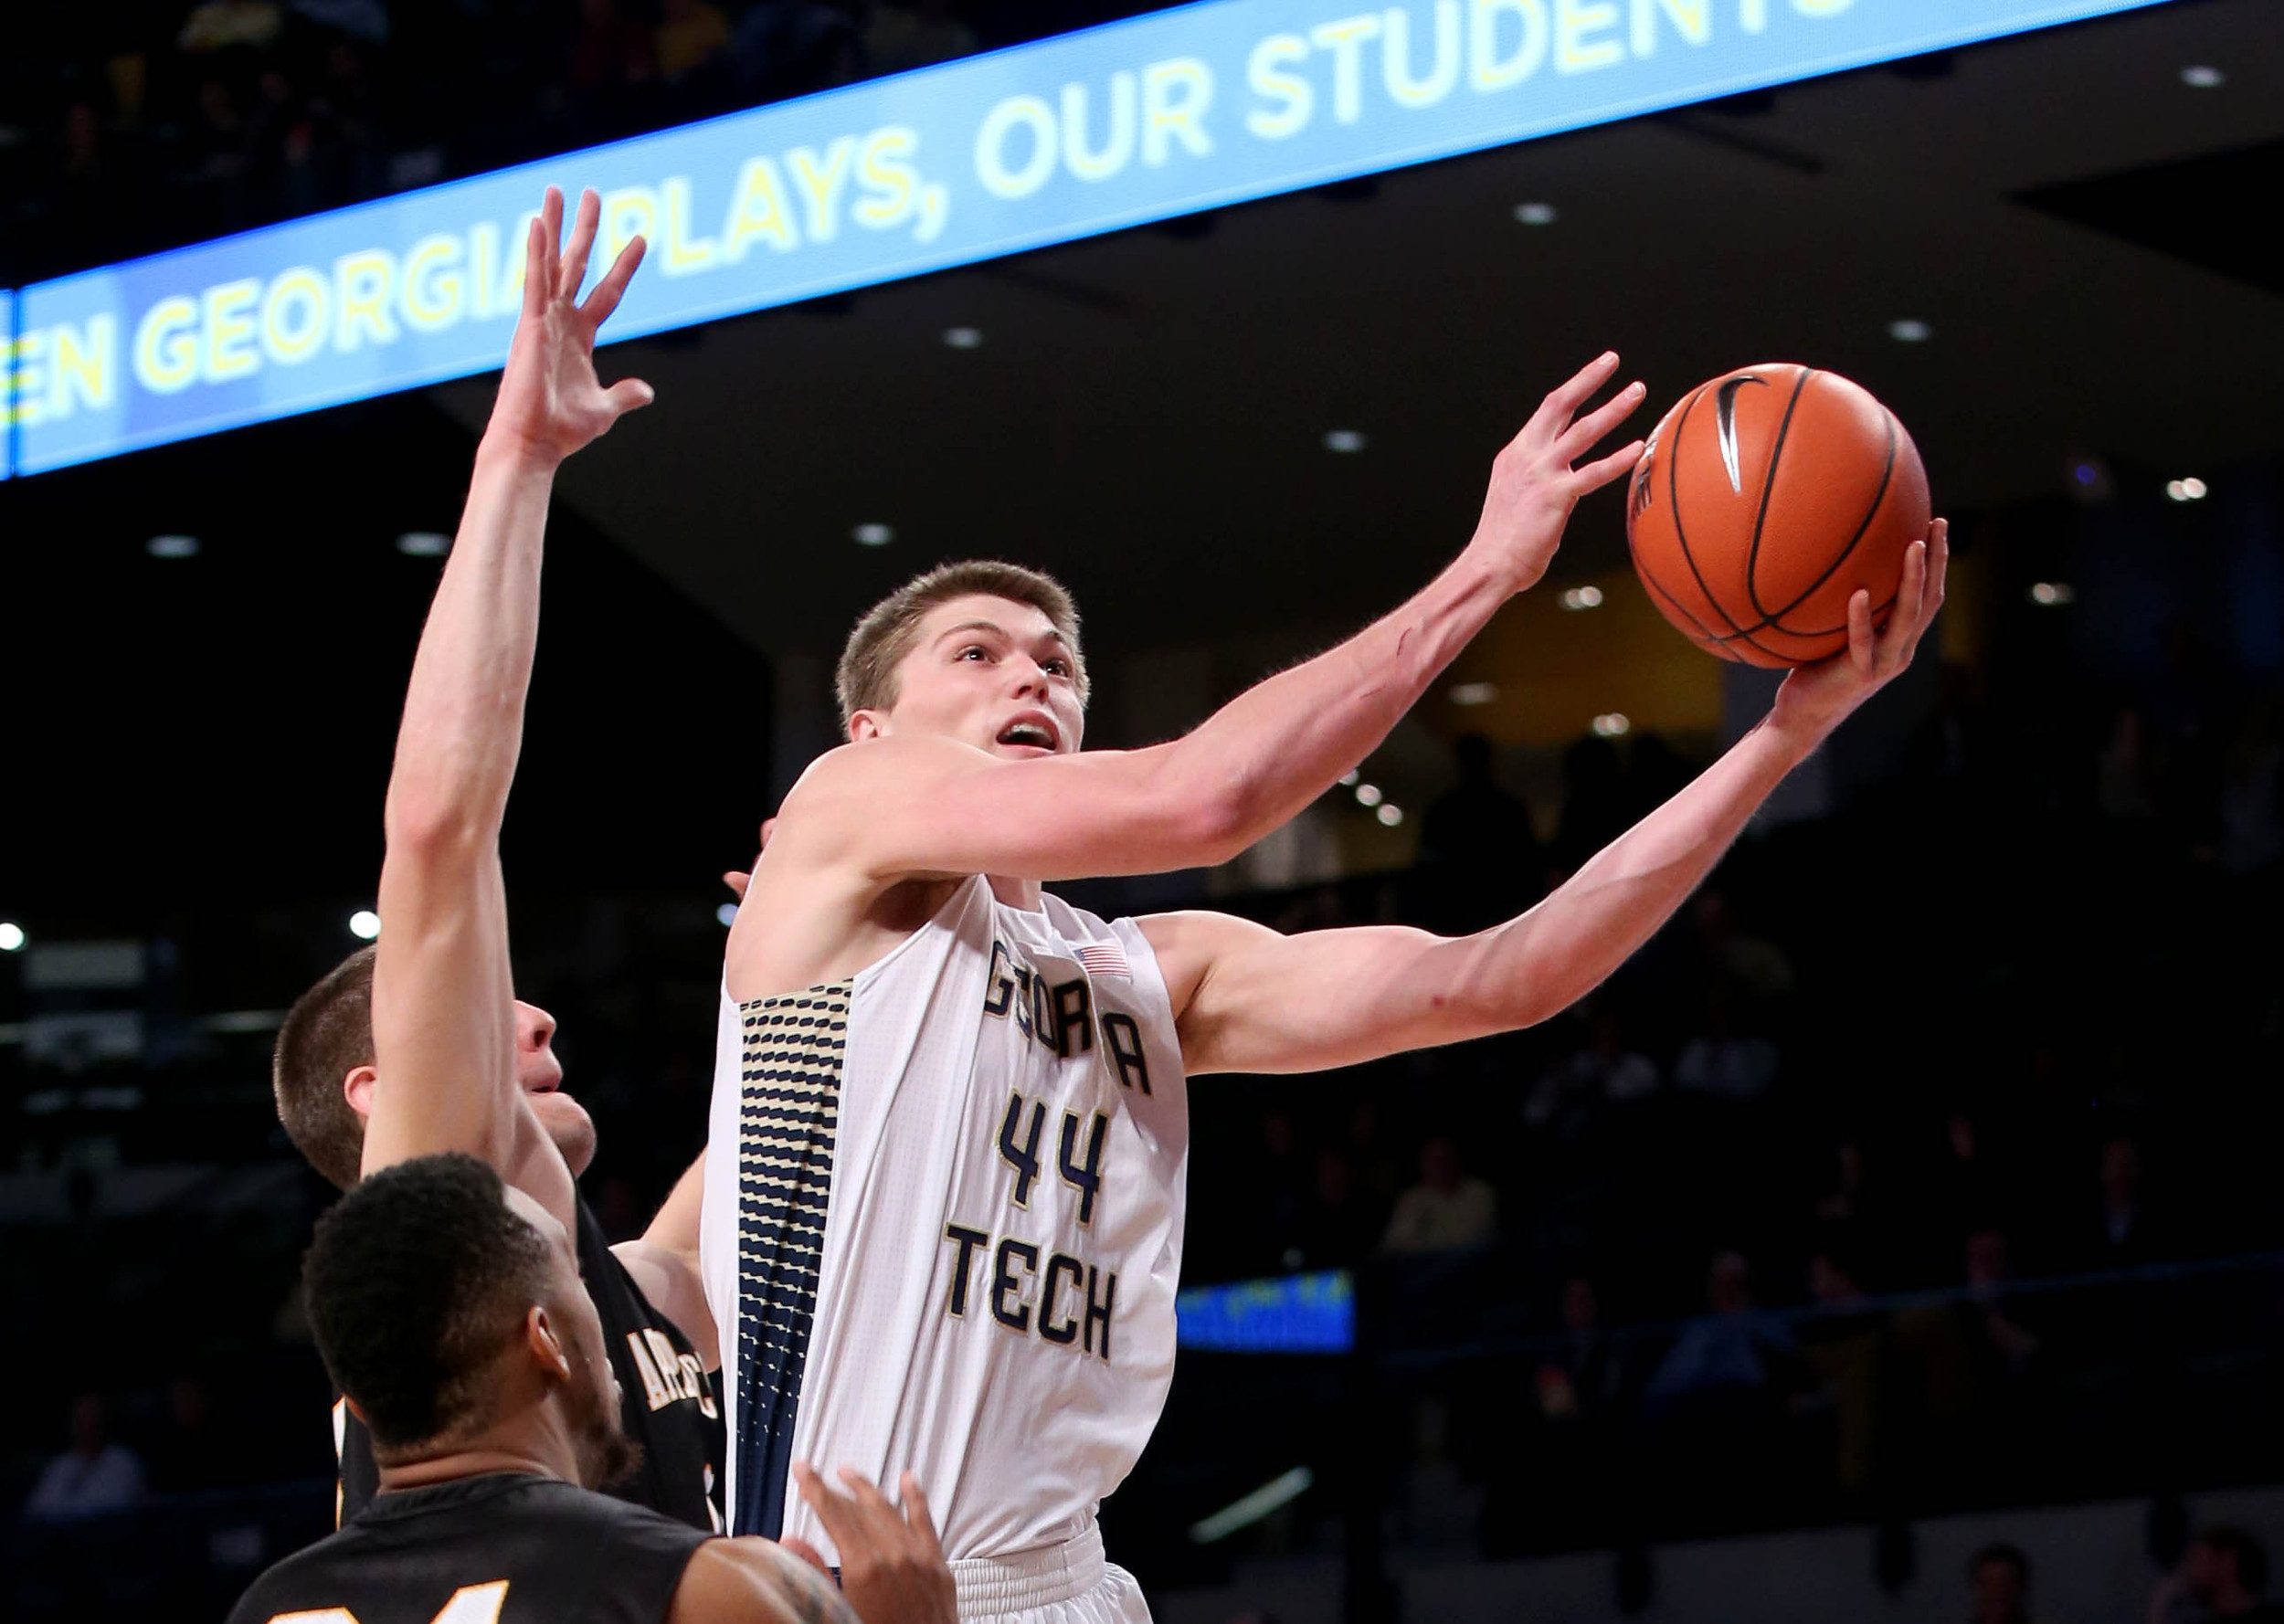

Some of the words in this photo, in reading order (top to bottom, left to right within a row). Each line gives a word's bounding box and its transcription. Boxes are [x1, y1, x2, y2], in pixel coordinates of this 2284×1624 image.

[599, 125, 946, 280] PLAYS,
[975, 58, 1214, 197] OUR
[997, 1088, 1109, 1227] 44
[945, 1222, 1116, 1365] TECH
